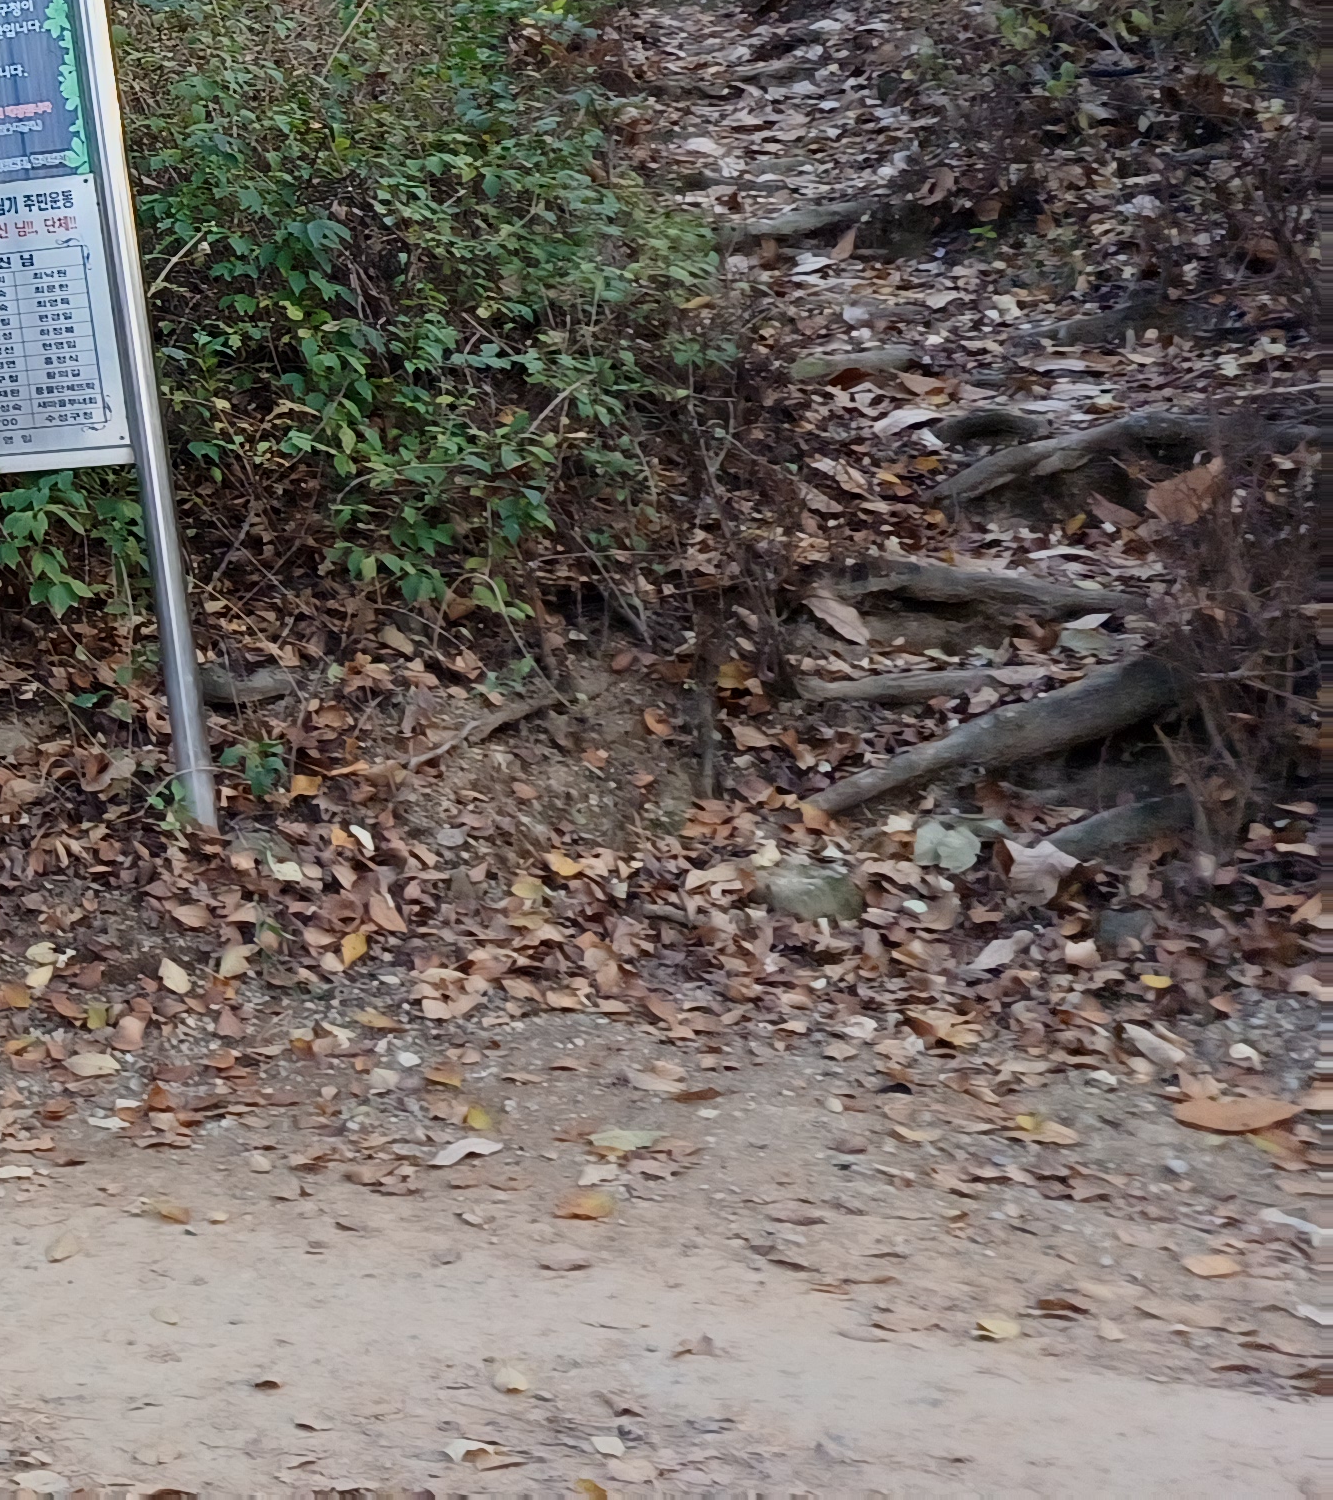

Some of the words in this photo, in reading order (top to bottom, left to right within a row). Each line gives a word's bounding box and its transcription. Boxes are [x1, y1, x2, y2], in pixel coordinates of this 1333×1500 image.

[22, 189, 74, 213] 주민운동
[19, 253, 35, 268] 님
[44, 411, 94, 423] 수성구청
